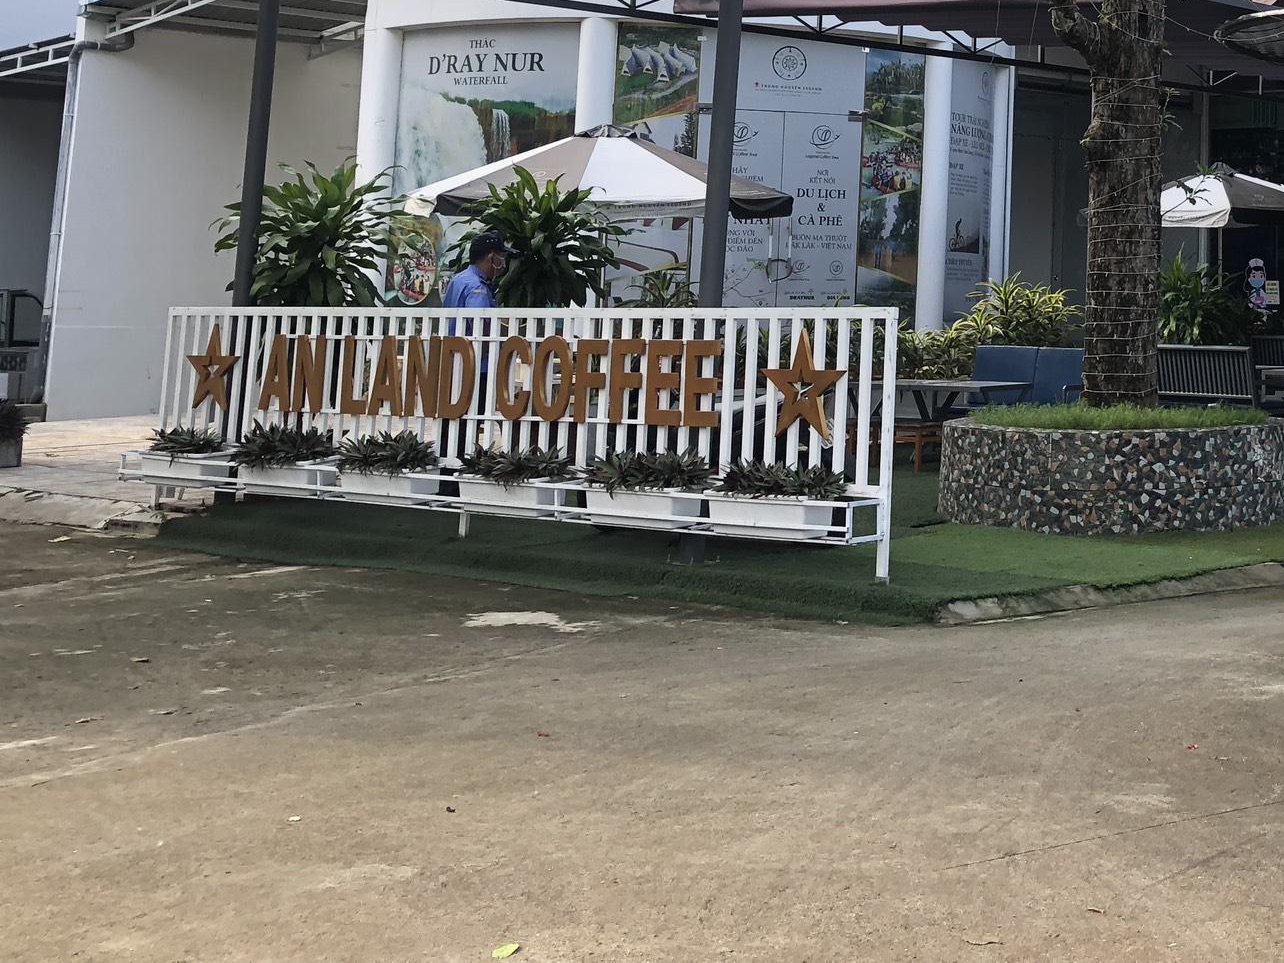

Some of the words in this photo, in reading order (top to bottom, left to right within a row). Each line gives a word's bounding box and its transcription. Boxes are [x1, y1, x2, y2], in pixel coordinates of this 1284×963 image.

[493, 52, 545, 72] NUR
[453, 76, 508, 86] WATERFALL
[797, 188, 815, 198] DU
[818, 189, 847, 200] LỊCH
[817, 203, 826, 212] &
[798, 214, 816, 226] CÀ
[819, 215, 843, 227] PHÊ
[257, 333, 326, 414] AN
[339, 334, 476, 421] LAND
[497, 334, 723, 428] COFFEE
